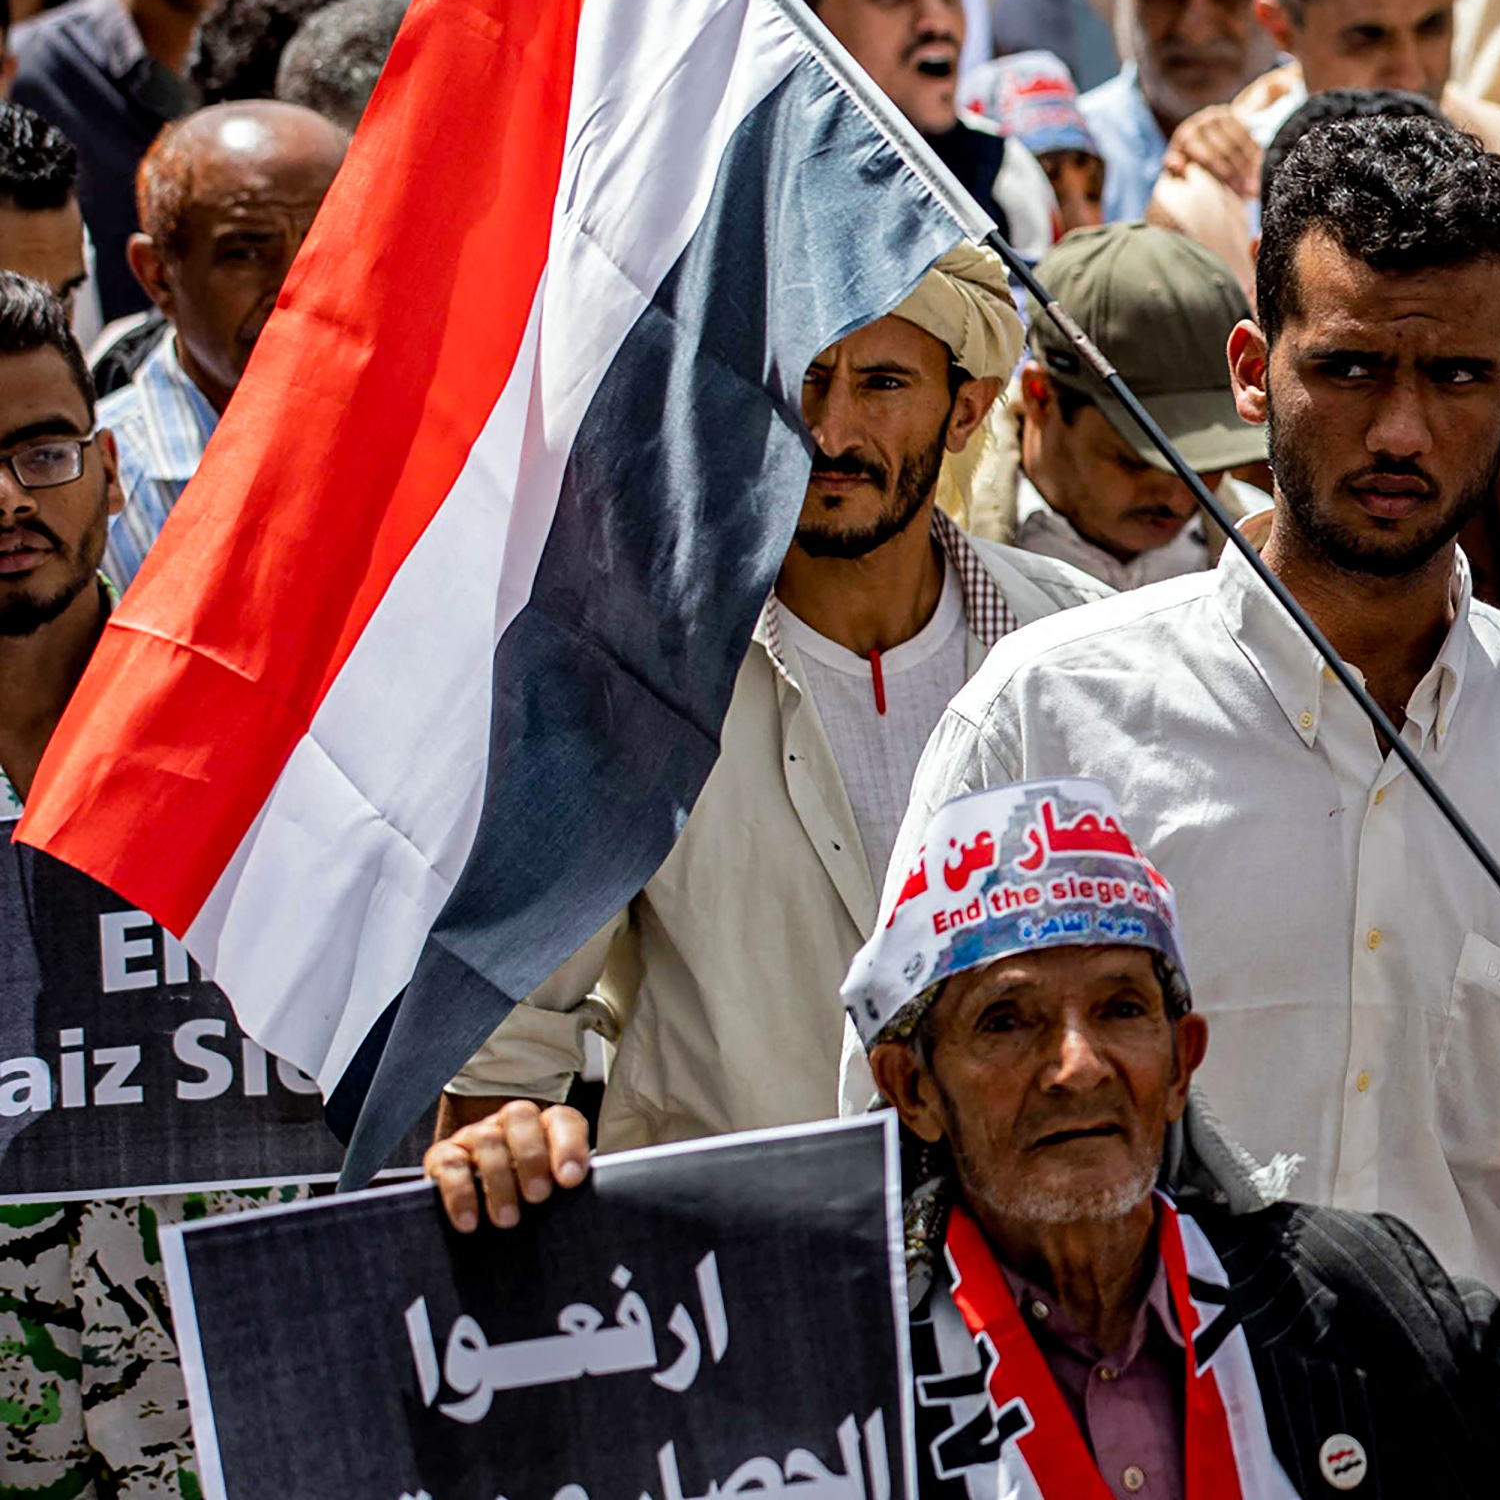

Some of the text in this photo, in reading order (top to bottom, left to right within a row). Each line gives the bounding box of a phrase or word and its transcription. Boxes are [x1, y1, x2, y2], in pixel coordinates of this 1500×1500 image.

[944, 830, 996, 893] عن
[932, 900, 982, 936] End
[991, 882, 1043, 912] the
[1052, 876, 1127, 905] siege
[0, 1027, 144, 1117] aiz
[405, 1250, 729, 1425] ارفعوا
